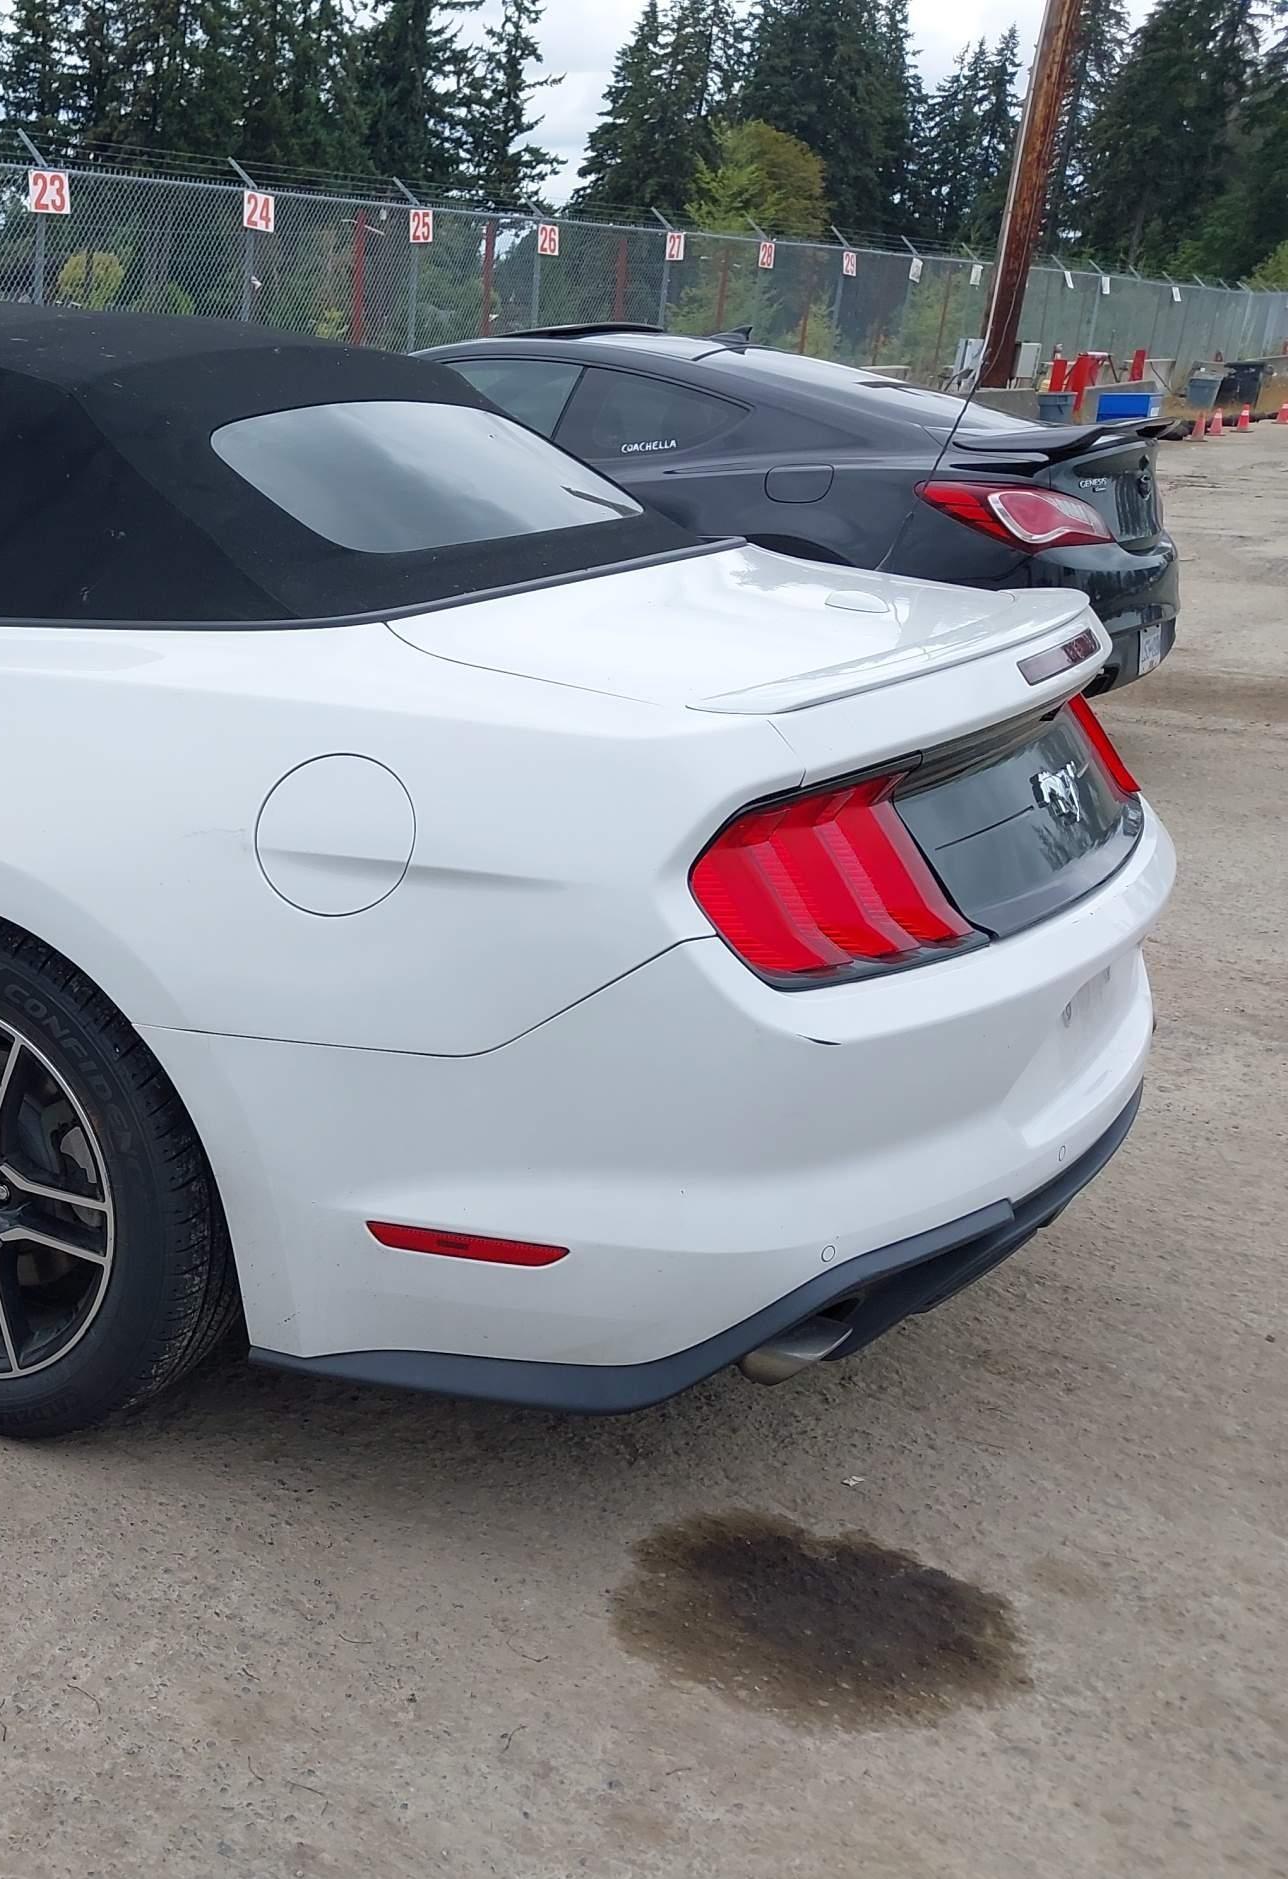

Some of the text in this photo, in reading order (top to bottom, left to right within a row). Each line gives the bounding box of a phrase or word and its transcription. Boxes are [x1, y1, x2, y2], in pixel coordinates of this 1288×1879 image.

[32, 173, 67, 213] 23
[246, 194, 272, 230] 24
[412, 211, 431, 242] 25
[539, 226, 557, 253] 26
[668, 235, 682, 258] 27
[761, 243, 773, 267] 28
[844, 253, 855, 275] 29
[621, 439, 677, 454] COACHELLA
